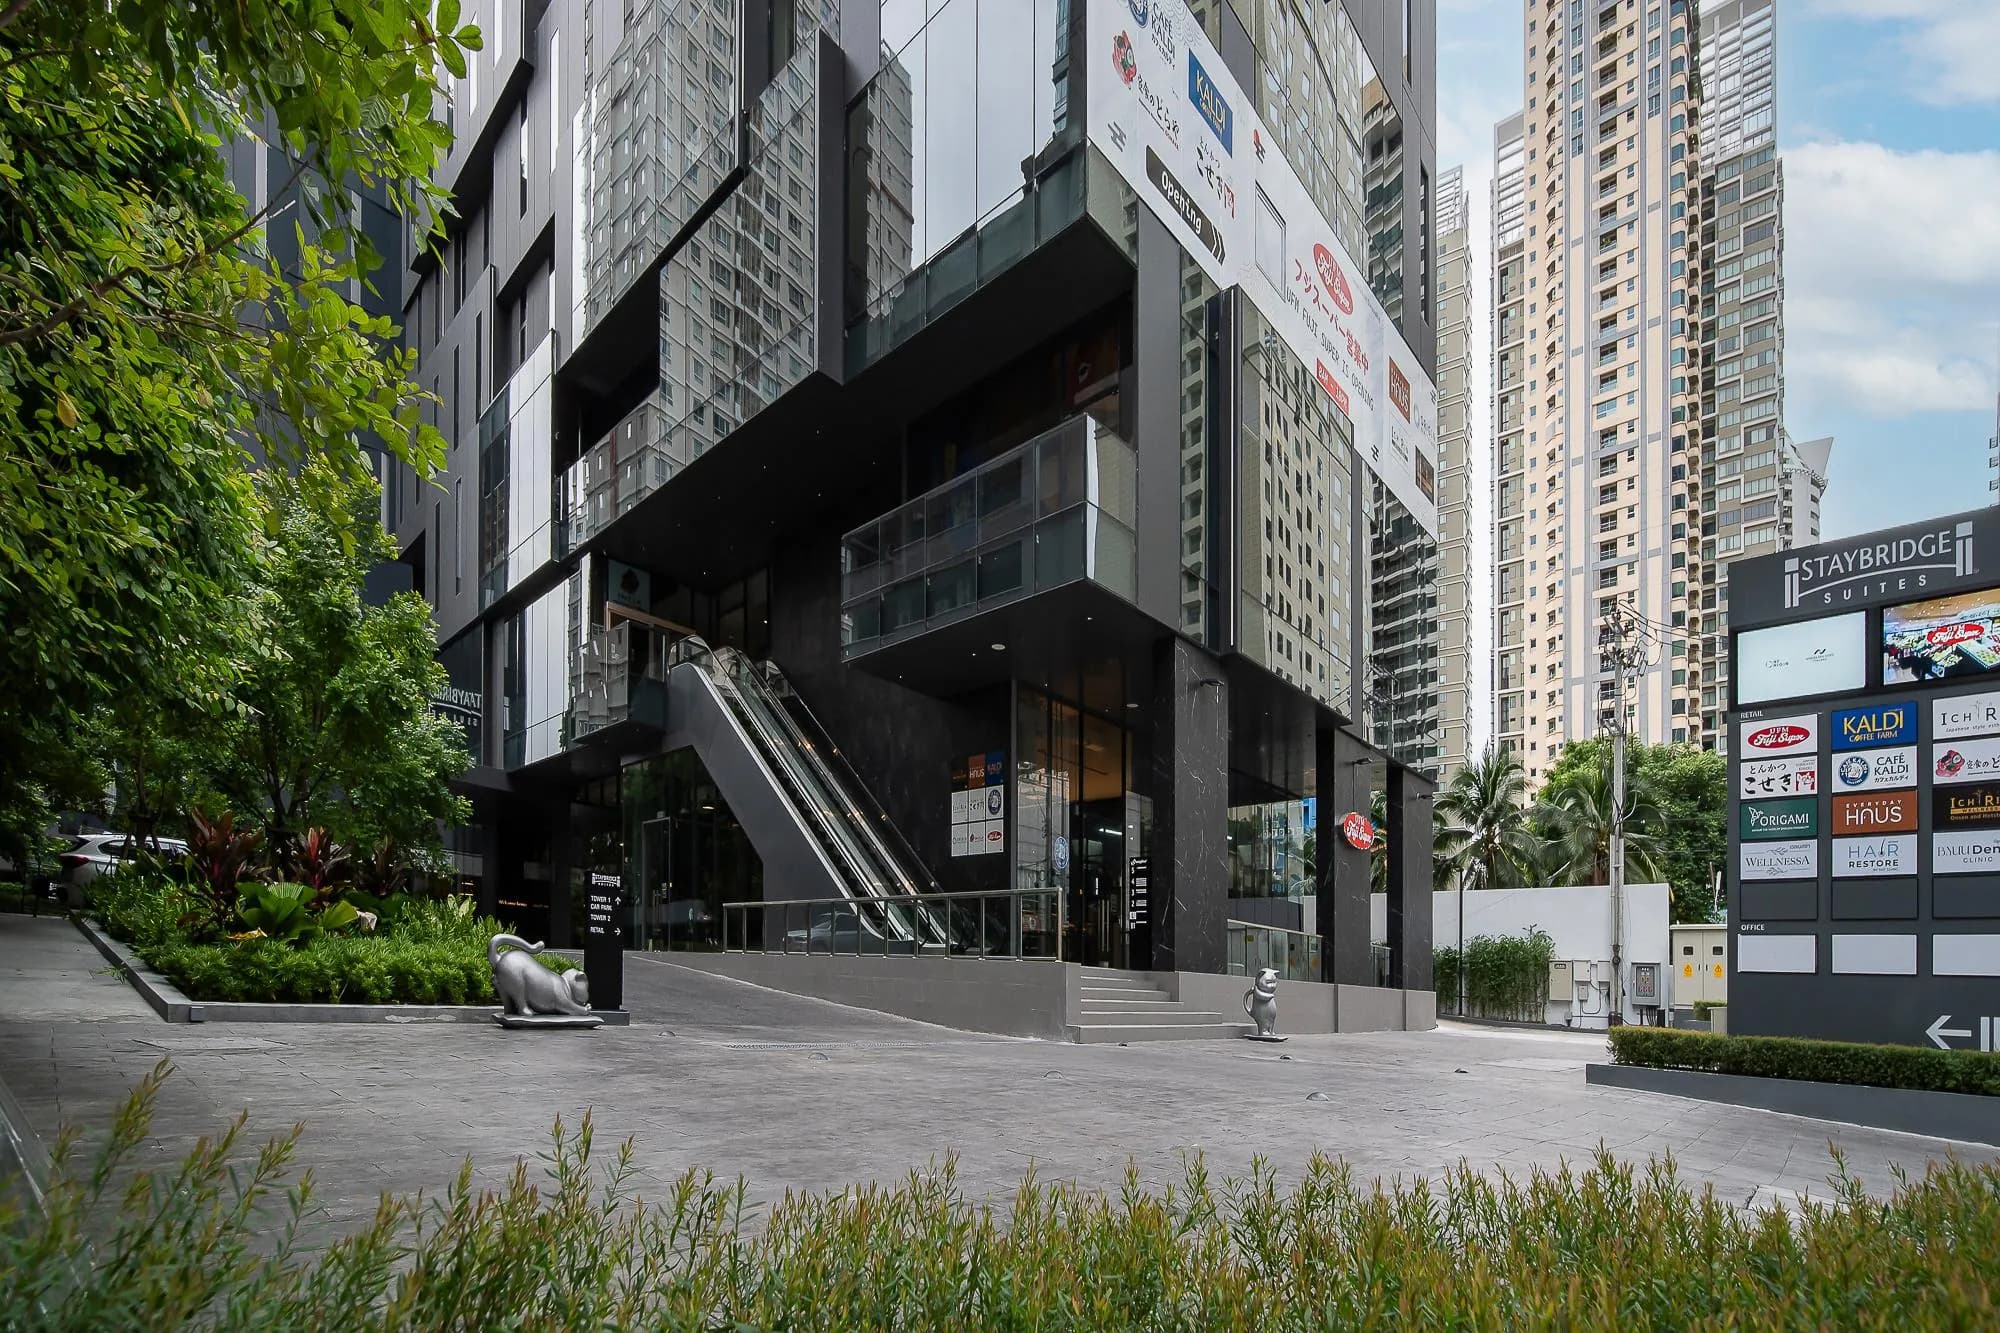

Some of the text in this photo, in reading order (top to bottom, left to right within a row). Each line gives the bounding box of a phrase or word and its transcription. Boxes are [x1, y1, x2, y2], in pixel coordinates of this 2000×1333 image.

[1153, 2, 1173, 40] CAFÉ
[1151, 15, 1176, 59] KALDI
[1196, 70, 1226, 131] KALDI
[1161, 171, 1202, 234] Opening
[1303, 307, 1318, 339] FUJI
[1320, 333, 1340, 364] SUPER
[1342, 360, 1349, 378] IS
[1351, 373, 1374, 411] OPENING
[1801, 530, 1952, 581] STAYBRIDGE
[1824, 574, 1927, 604] SUITES
[1741, 710, 1763, 719] RETAIL
[1843, 710, 1904, 735] KALDI
[1754, 732, 1806, 746] Fuji Super
[1849, 730, 1898, 742] COFFEE FARM
[1876, 752, 1906, 765] CAFÉ
[1749, 763, 1787, 774] とんかつ
[1874, 764, 1909, 775] KALDI
[1846, 800, 1902, 808] EVERYDAY
[1760, 813, 1809, 826] ORIGAMI
[1846, 806, 1902, 826] HAUS
[1745, 855, 1810, 867] WELLNESSA
[1848, 860, 1899, 868] RESTORE
[591, 913, 607, 921] TOWER
[1741, 923, 1765, 931] OFFICE
